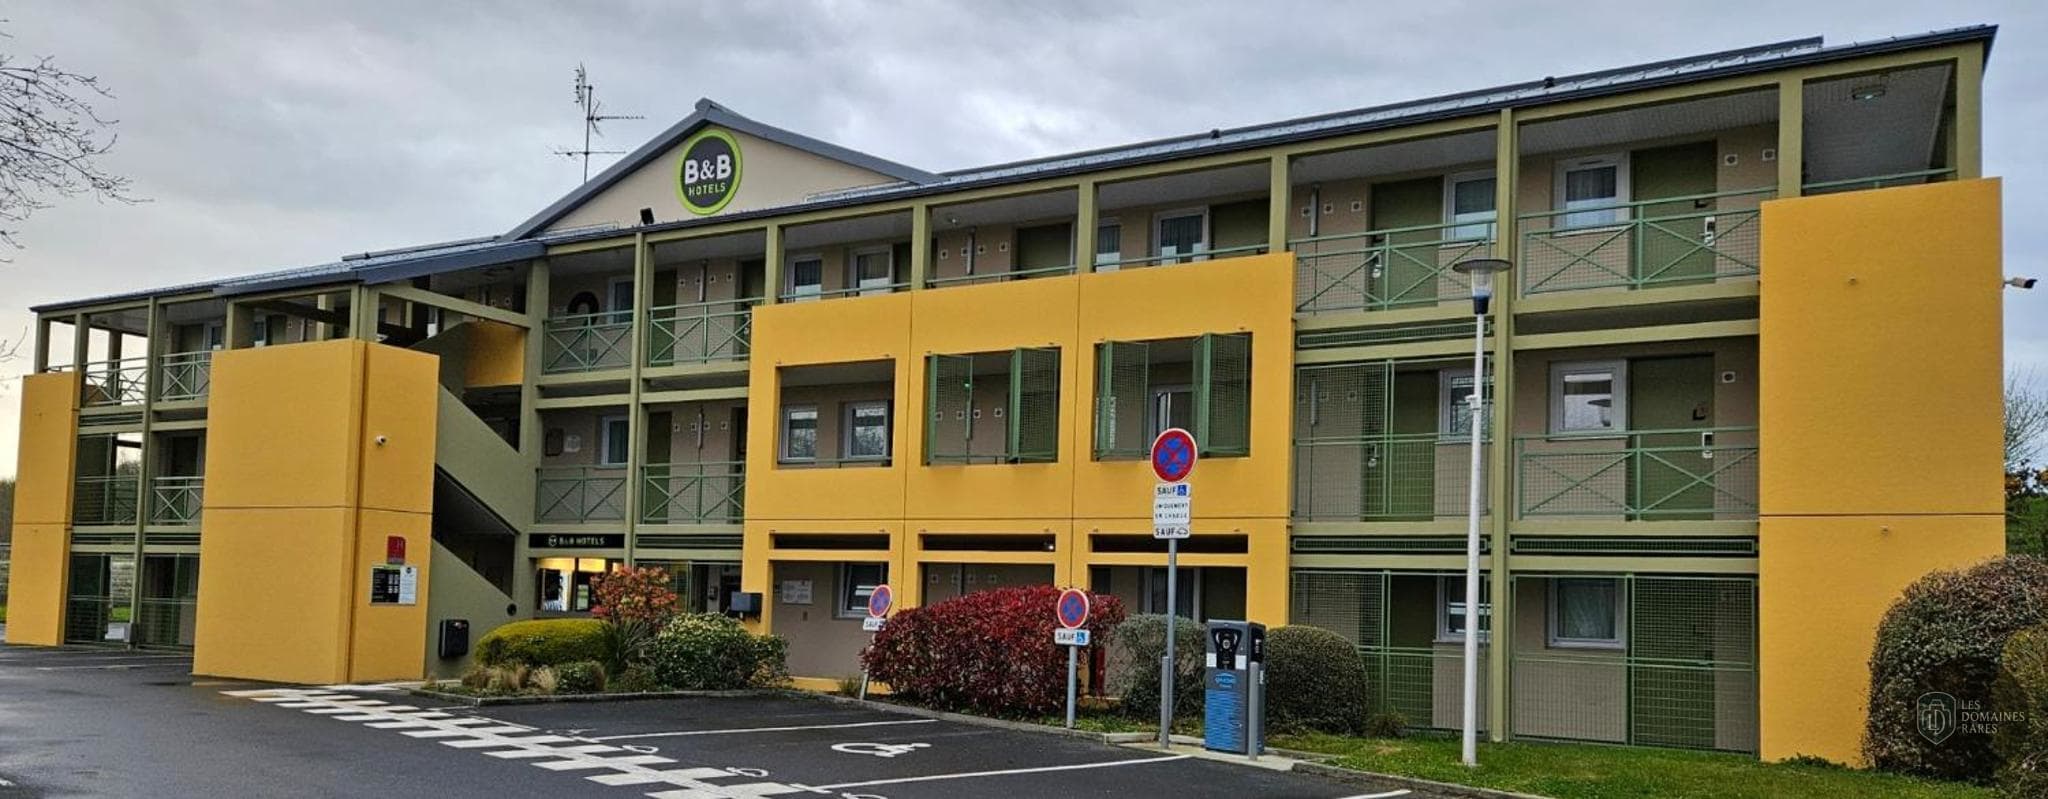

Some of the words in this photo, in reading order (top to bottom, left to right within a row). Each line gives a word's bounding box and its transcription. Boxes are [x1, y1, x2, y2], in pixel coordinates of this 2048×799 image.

[685, 154, 731, 185] B&B
[688, 182, 726, 197] HOTELS
[1157, 486, 1176, 496] SAUF
[1155, 527, 1175, 537] SAUF
[576, 536, 606, 545] HOTELS
[1057, 631, 1076, 641] SAUF
